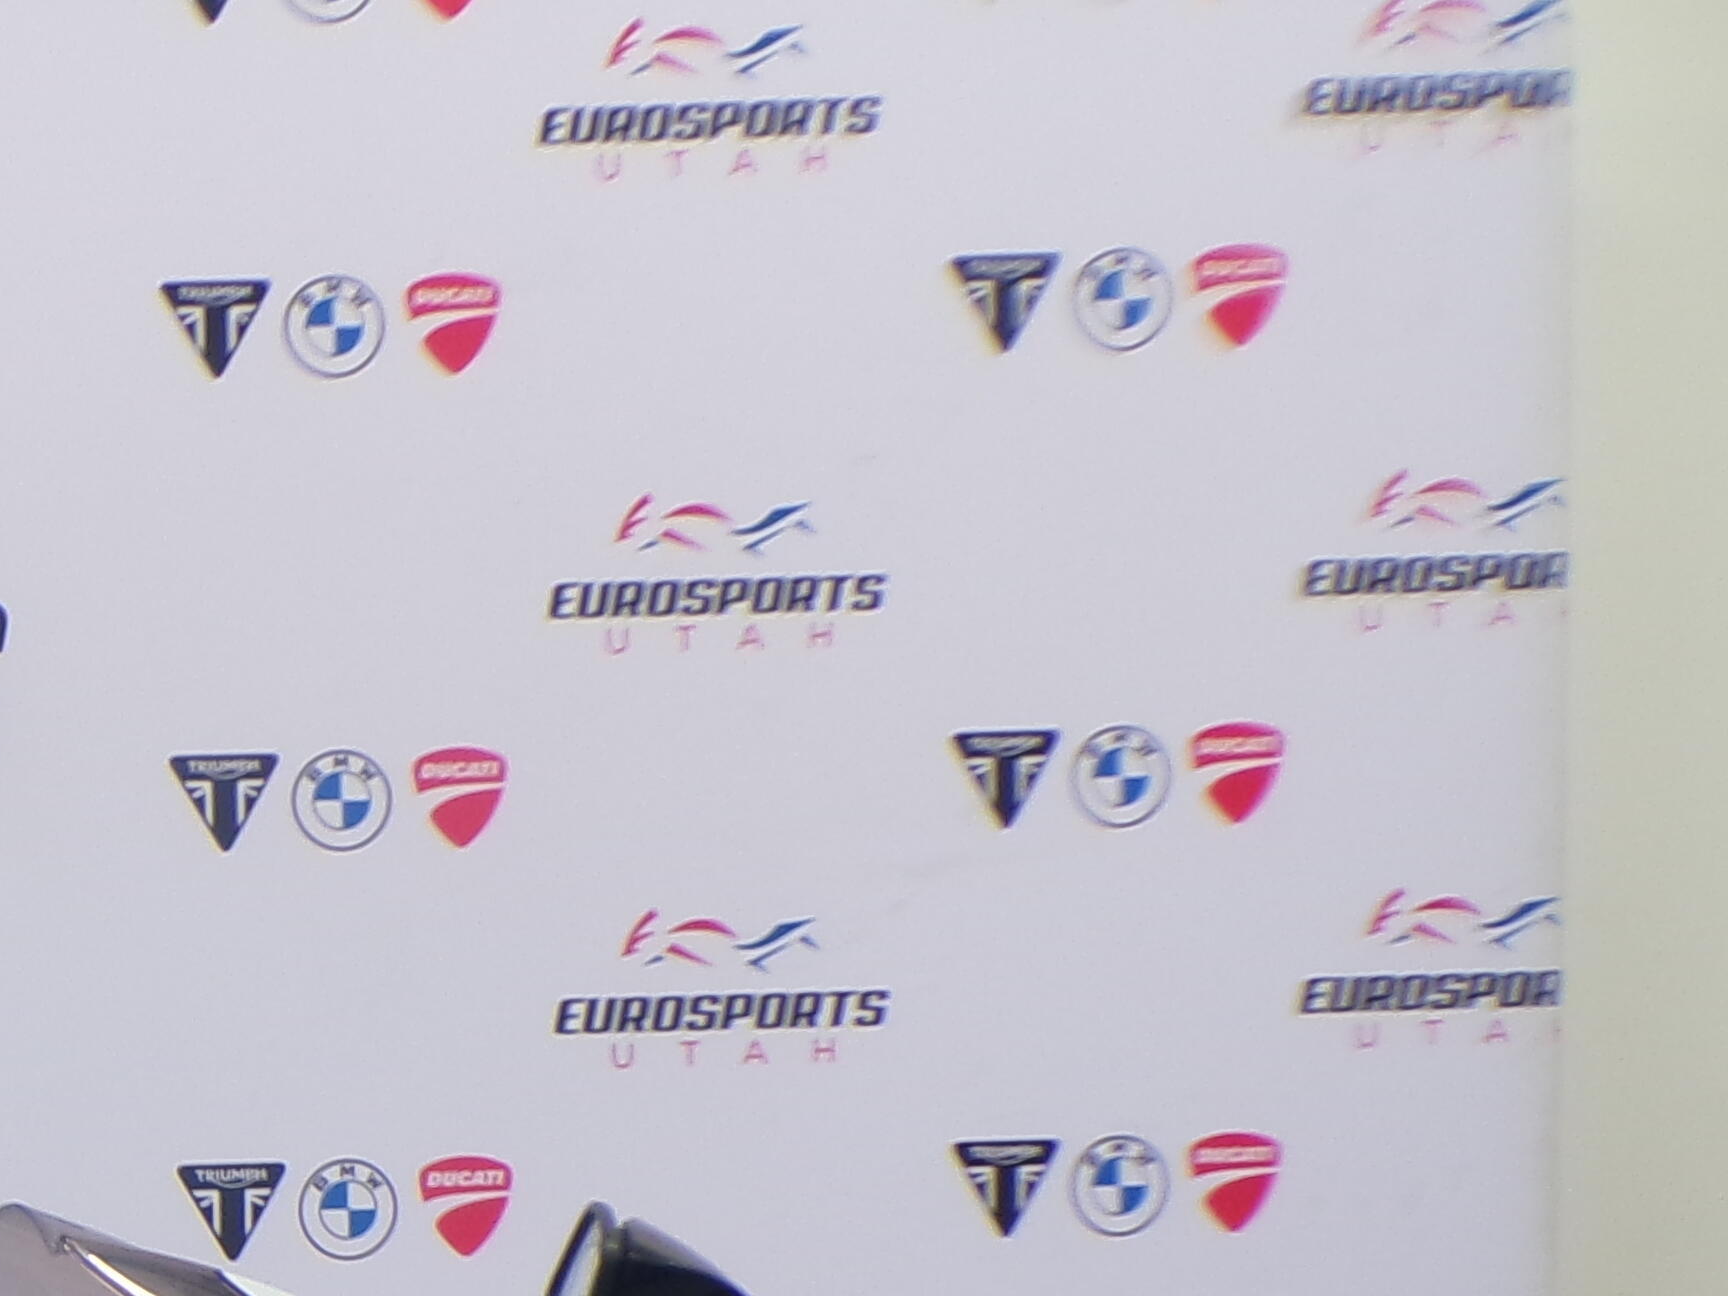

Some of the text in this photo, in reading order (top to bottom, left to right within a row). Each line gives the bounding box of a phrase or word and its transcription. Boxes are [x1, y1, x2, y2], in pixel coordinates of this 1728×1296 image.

[539, 95, 883, 147] EUROSPORTS
[595, 147, 829, 183] UTAH
[548, 573, 887, 621] EUROSPORTS
[604, 622, 836, 656] UTAH
[554, 989, 890, 1035] EUROSPORTS
[610, 1038, 838, 1070] UTAH
[193, 1168, 270, 1184] TRIUMPH
[426, 1169, 506, 1188] DUCATI
